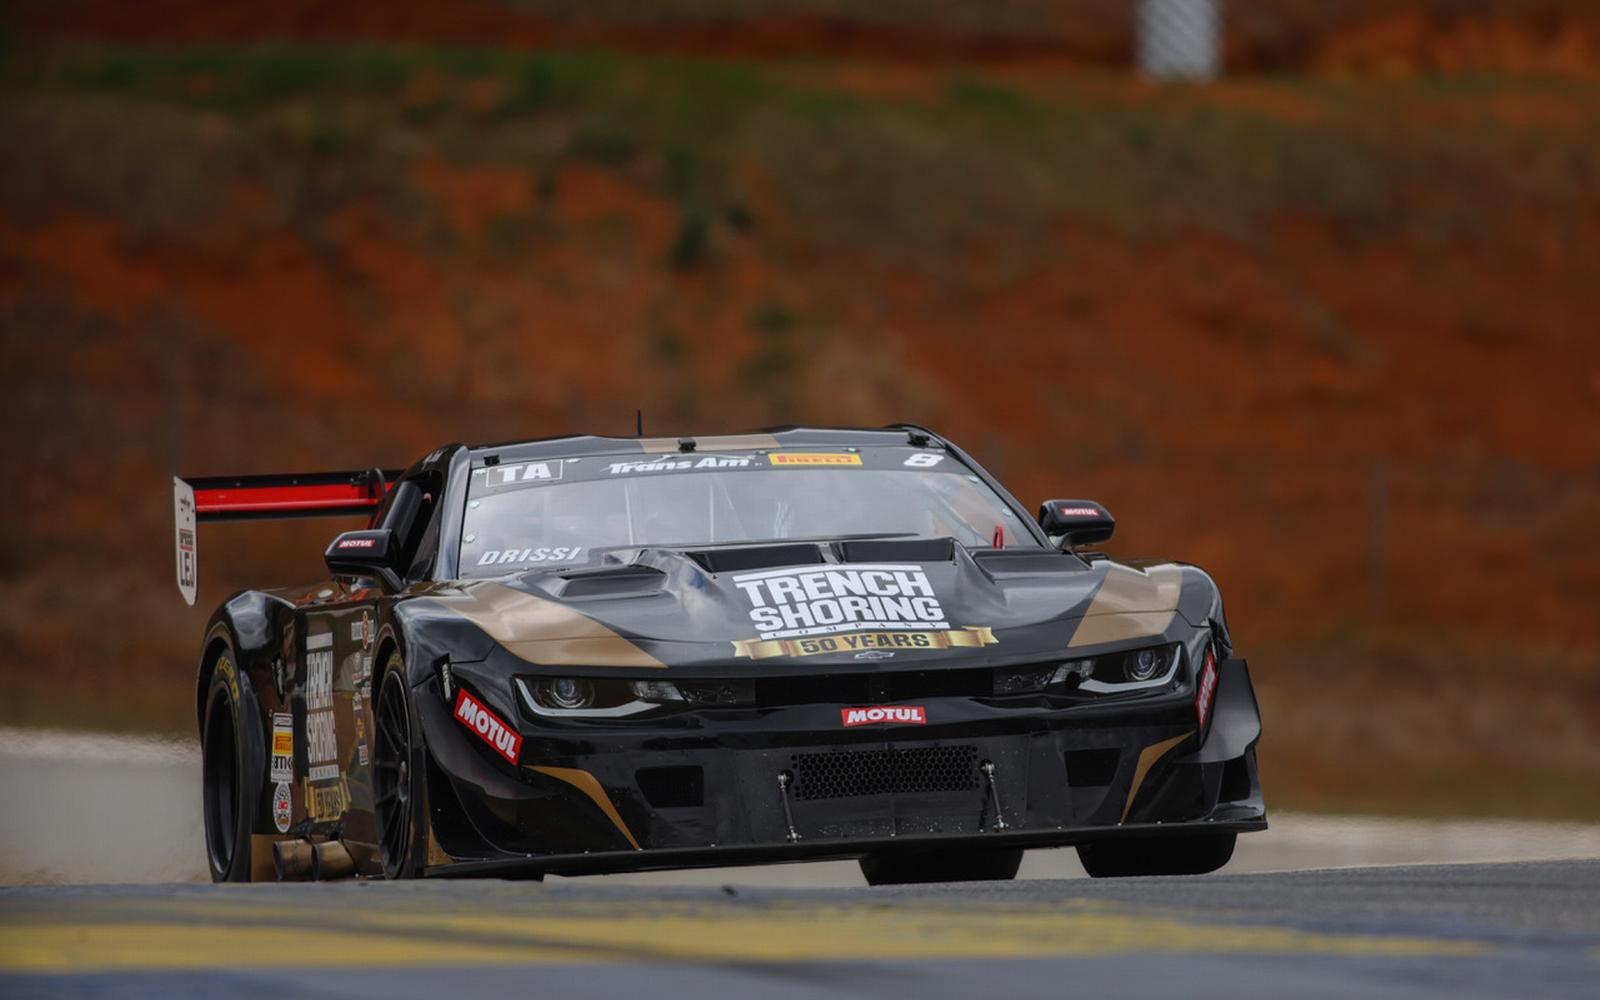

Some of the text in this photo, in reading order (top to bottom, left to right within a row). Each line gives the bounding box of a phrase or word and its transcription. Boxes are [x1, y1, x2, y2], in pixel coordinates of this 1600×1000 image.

[608, 456, 750, 474] Trans Am
[777, 455, 852, 463] PIRELLI
[904, 453, 944, 467] 8
[497, 462, 552, 482] TA
[1064, 508, 1099, 516] MOTUL
[338, 540, 375, 548] MOTUL
[478, 547, 582, 566] DRISSI
[736, 571, 935, 607] TRENCH
[749, 597, 945, 631] SHORING
[800, 633, 930, 653] 50 YEARS
[847, 707, 922, 724] MOTUL
[458, 697, 516, 759] MOTUL
